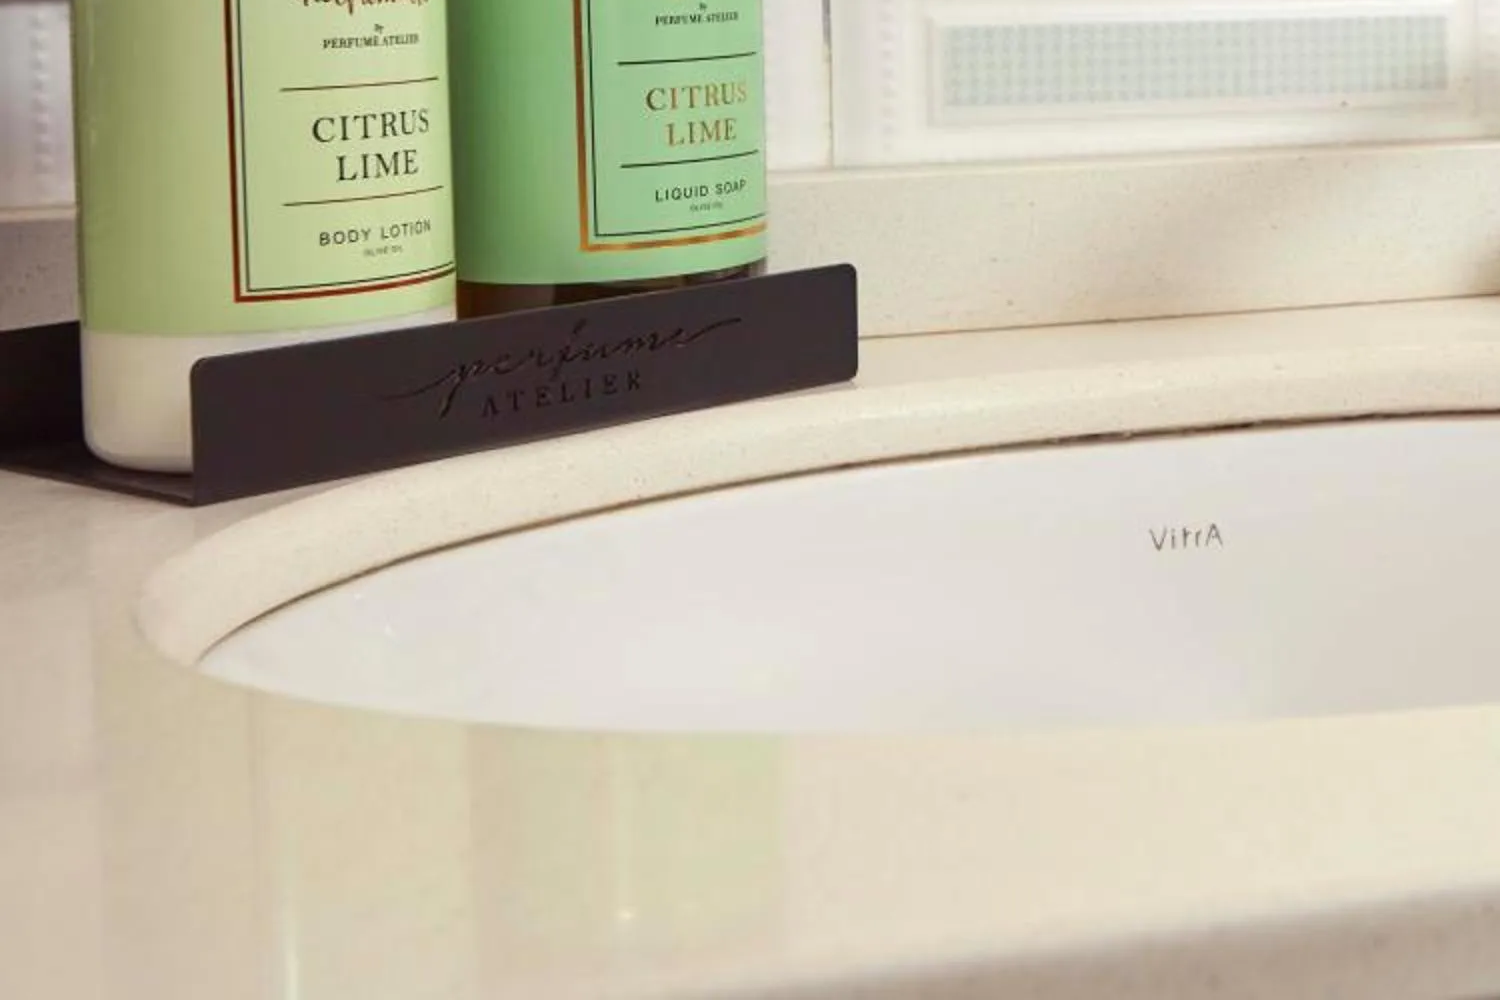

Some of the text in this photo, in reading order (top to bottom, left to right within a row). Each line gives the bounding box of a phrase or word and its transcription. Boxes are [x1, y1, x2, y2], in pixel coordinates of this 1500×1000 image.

[323, 33, 419, 49] PERFUME ATELIER
[646, 80, 747, 111] CITRUS
[312, 108, 429, 143] CITRUS
[667, 118, 737, 146] LIME
[336, 149, 419, 182] LIME
[655, 179, 746, 202] LIQUID SOAP
[319, 219, 431, 247] BODY LOTION
[481, 369, 641, 418] ATELIER
